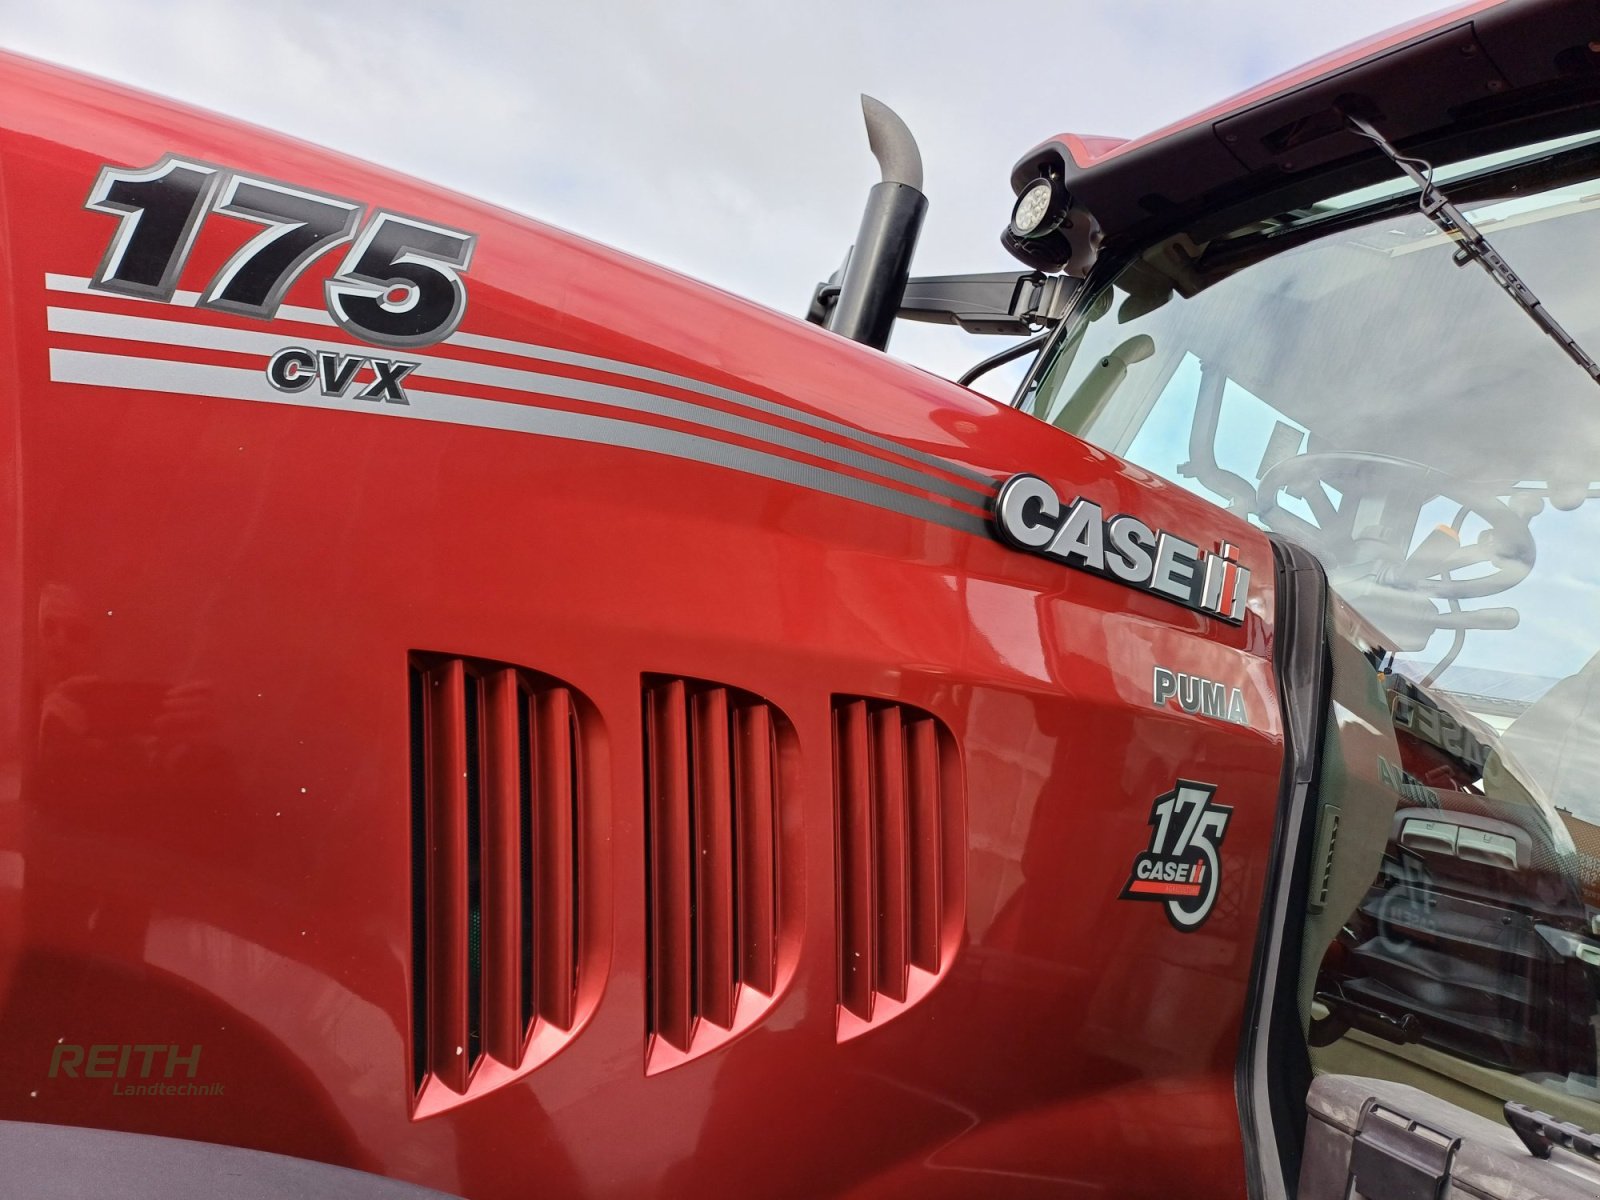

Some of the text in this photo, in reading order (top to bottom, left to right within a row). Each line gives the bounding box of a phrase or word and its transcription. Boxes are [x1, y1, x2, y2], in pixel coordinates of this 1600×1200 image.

[81, 152, 478, 348] 175
[266, 346, 421, 405] CVX
[997, 473, 1199, 601] CASE
[1153, 666, 1249, 725] PUMA
[1136, 859, 1190, 882] CASE
[1151, 787, 1228, 926] 175
